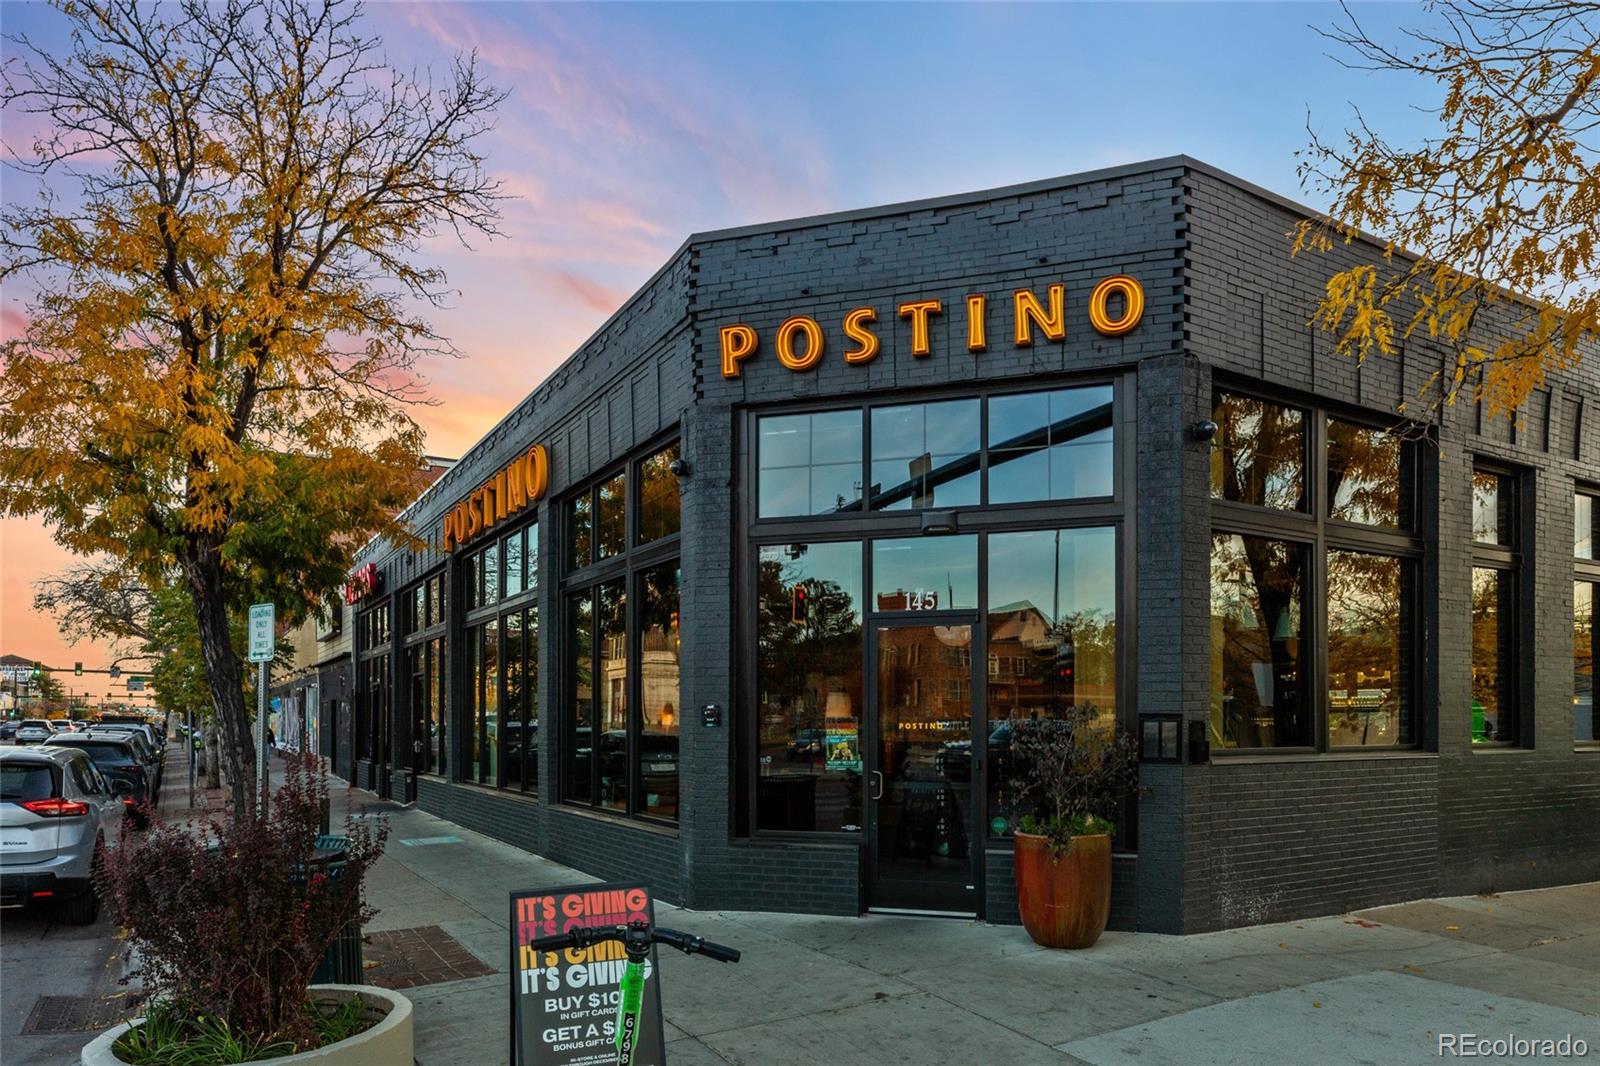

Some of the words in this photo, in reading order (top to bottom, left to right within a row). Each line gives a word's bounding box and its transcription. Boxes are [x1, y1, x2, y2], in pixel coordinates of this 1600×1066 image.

[719, 275, 1146, 379] POSTINO
[443, 444, 548, 553] POSTINO
[905, 591, 935, 611] 145
[898, 722, 943, 730] POSTINO
[517, 896, 556, 922] IT'S
[561, 888, 647, 918] GIVING
[520, 944, 559, 970] ITS
[564, 940, 630, 965] GIVIN
[520, 966, 560, 995] IT'S
[544, 995, 584, 1013] BUY
[560, 1012, 570, 1020] IN
[571, 1009, 590, 1019] GIFT
[542, 1025, 582, 1043] GET
[585, 1023, 599, 1038] A
[553, 1042, 585, 1052] BONUS
[585, 1038, 605, 1048] GIFT
